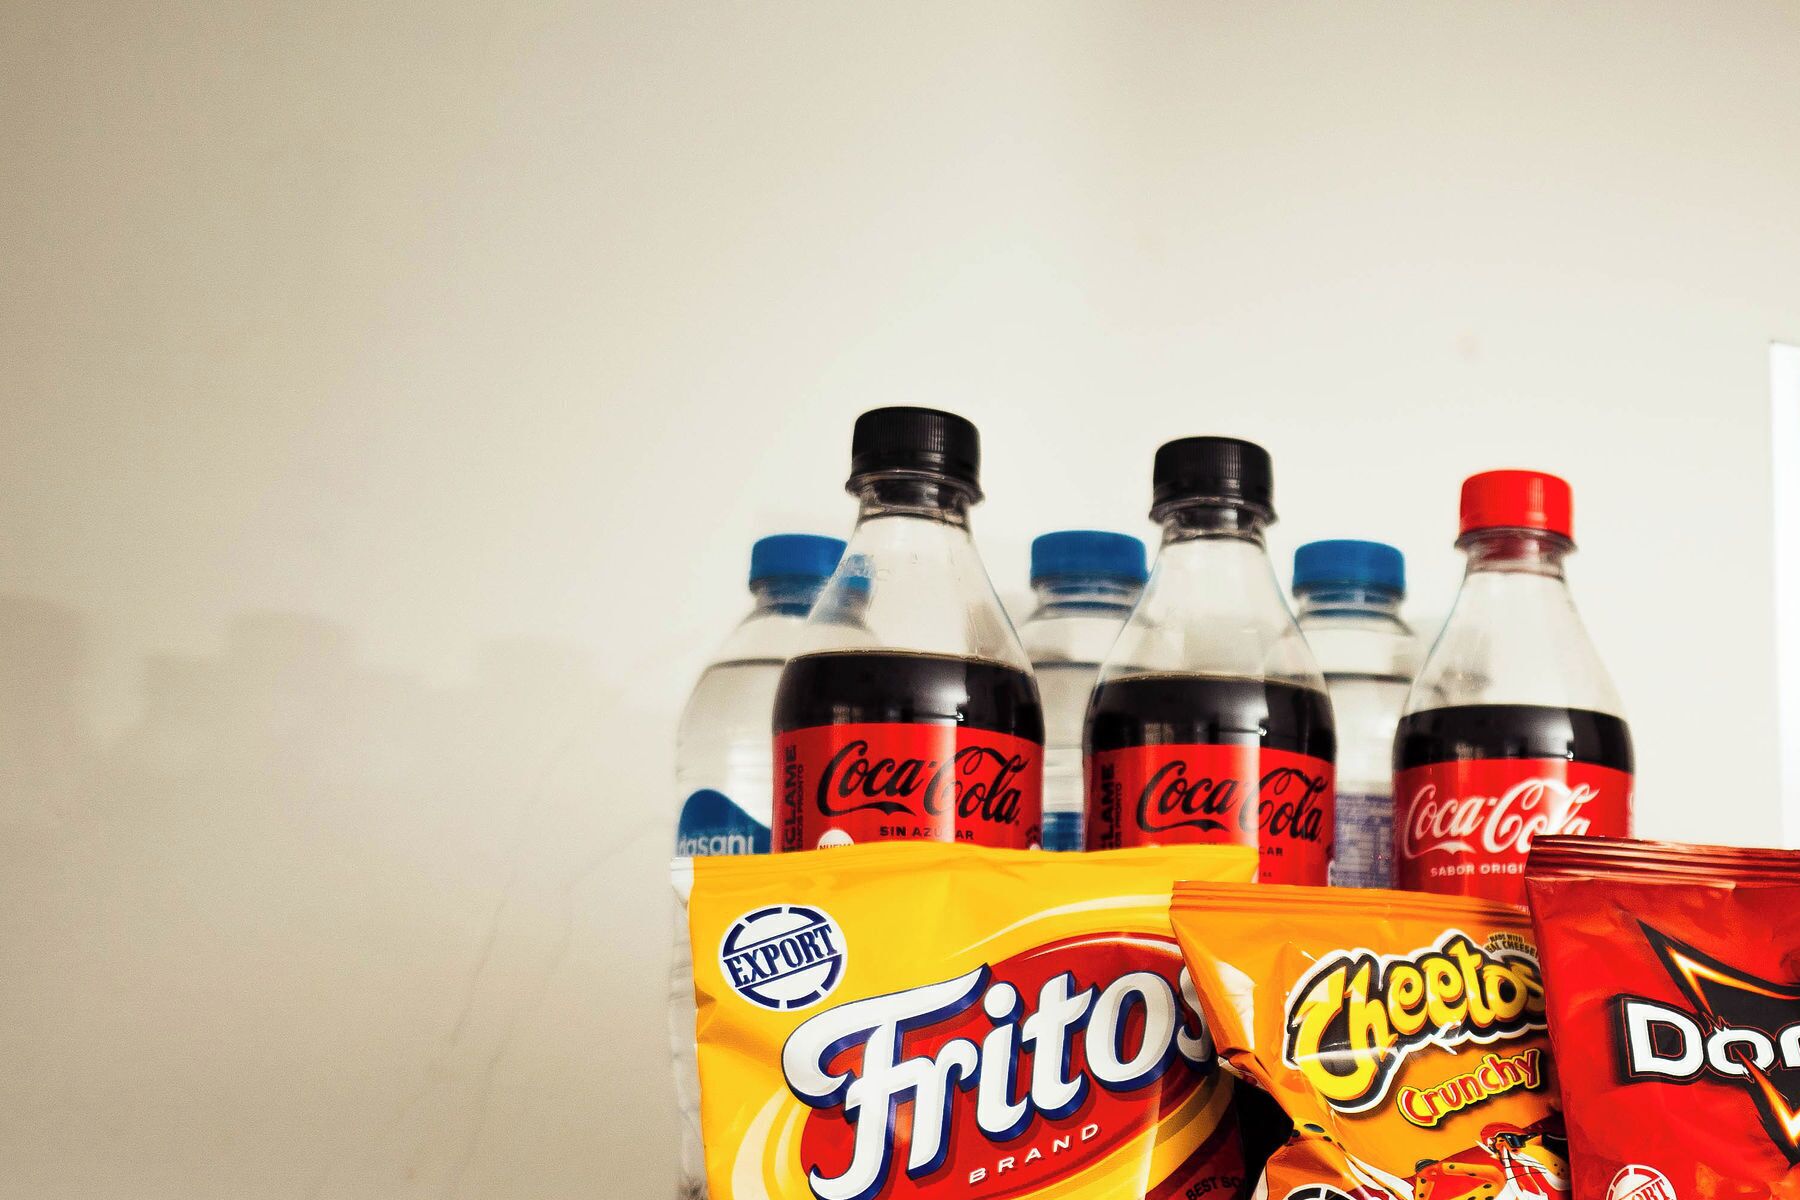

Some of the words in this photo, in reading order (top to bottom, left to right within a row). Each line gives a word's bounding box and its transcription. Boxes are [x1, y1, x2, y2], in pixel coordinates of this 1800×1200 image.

[880, 826, 907, 837] SIN
[912, 826, 974, 840] AZUAR
[1430, 863, 1474, 877] SABOR
[1480, 862, 1524, 875] ORIGI
[723, 924, 837, 988] EXPORT
[1289, 935, 1546, 1105] Cheetos
[1397, 1048, 1541, 1127] Crunchy
[969, 1122, 1100, 1184] BRAND
